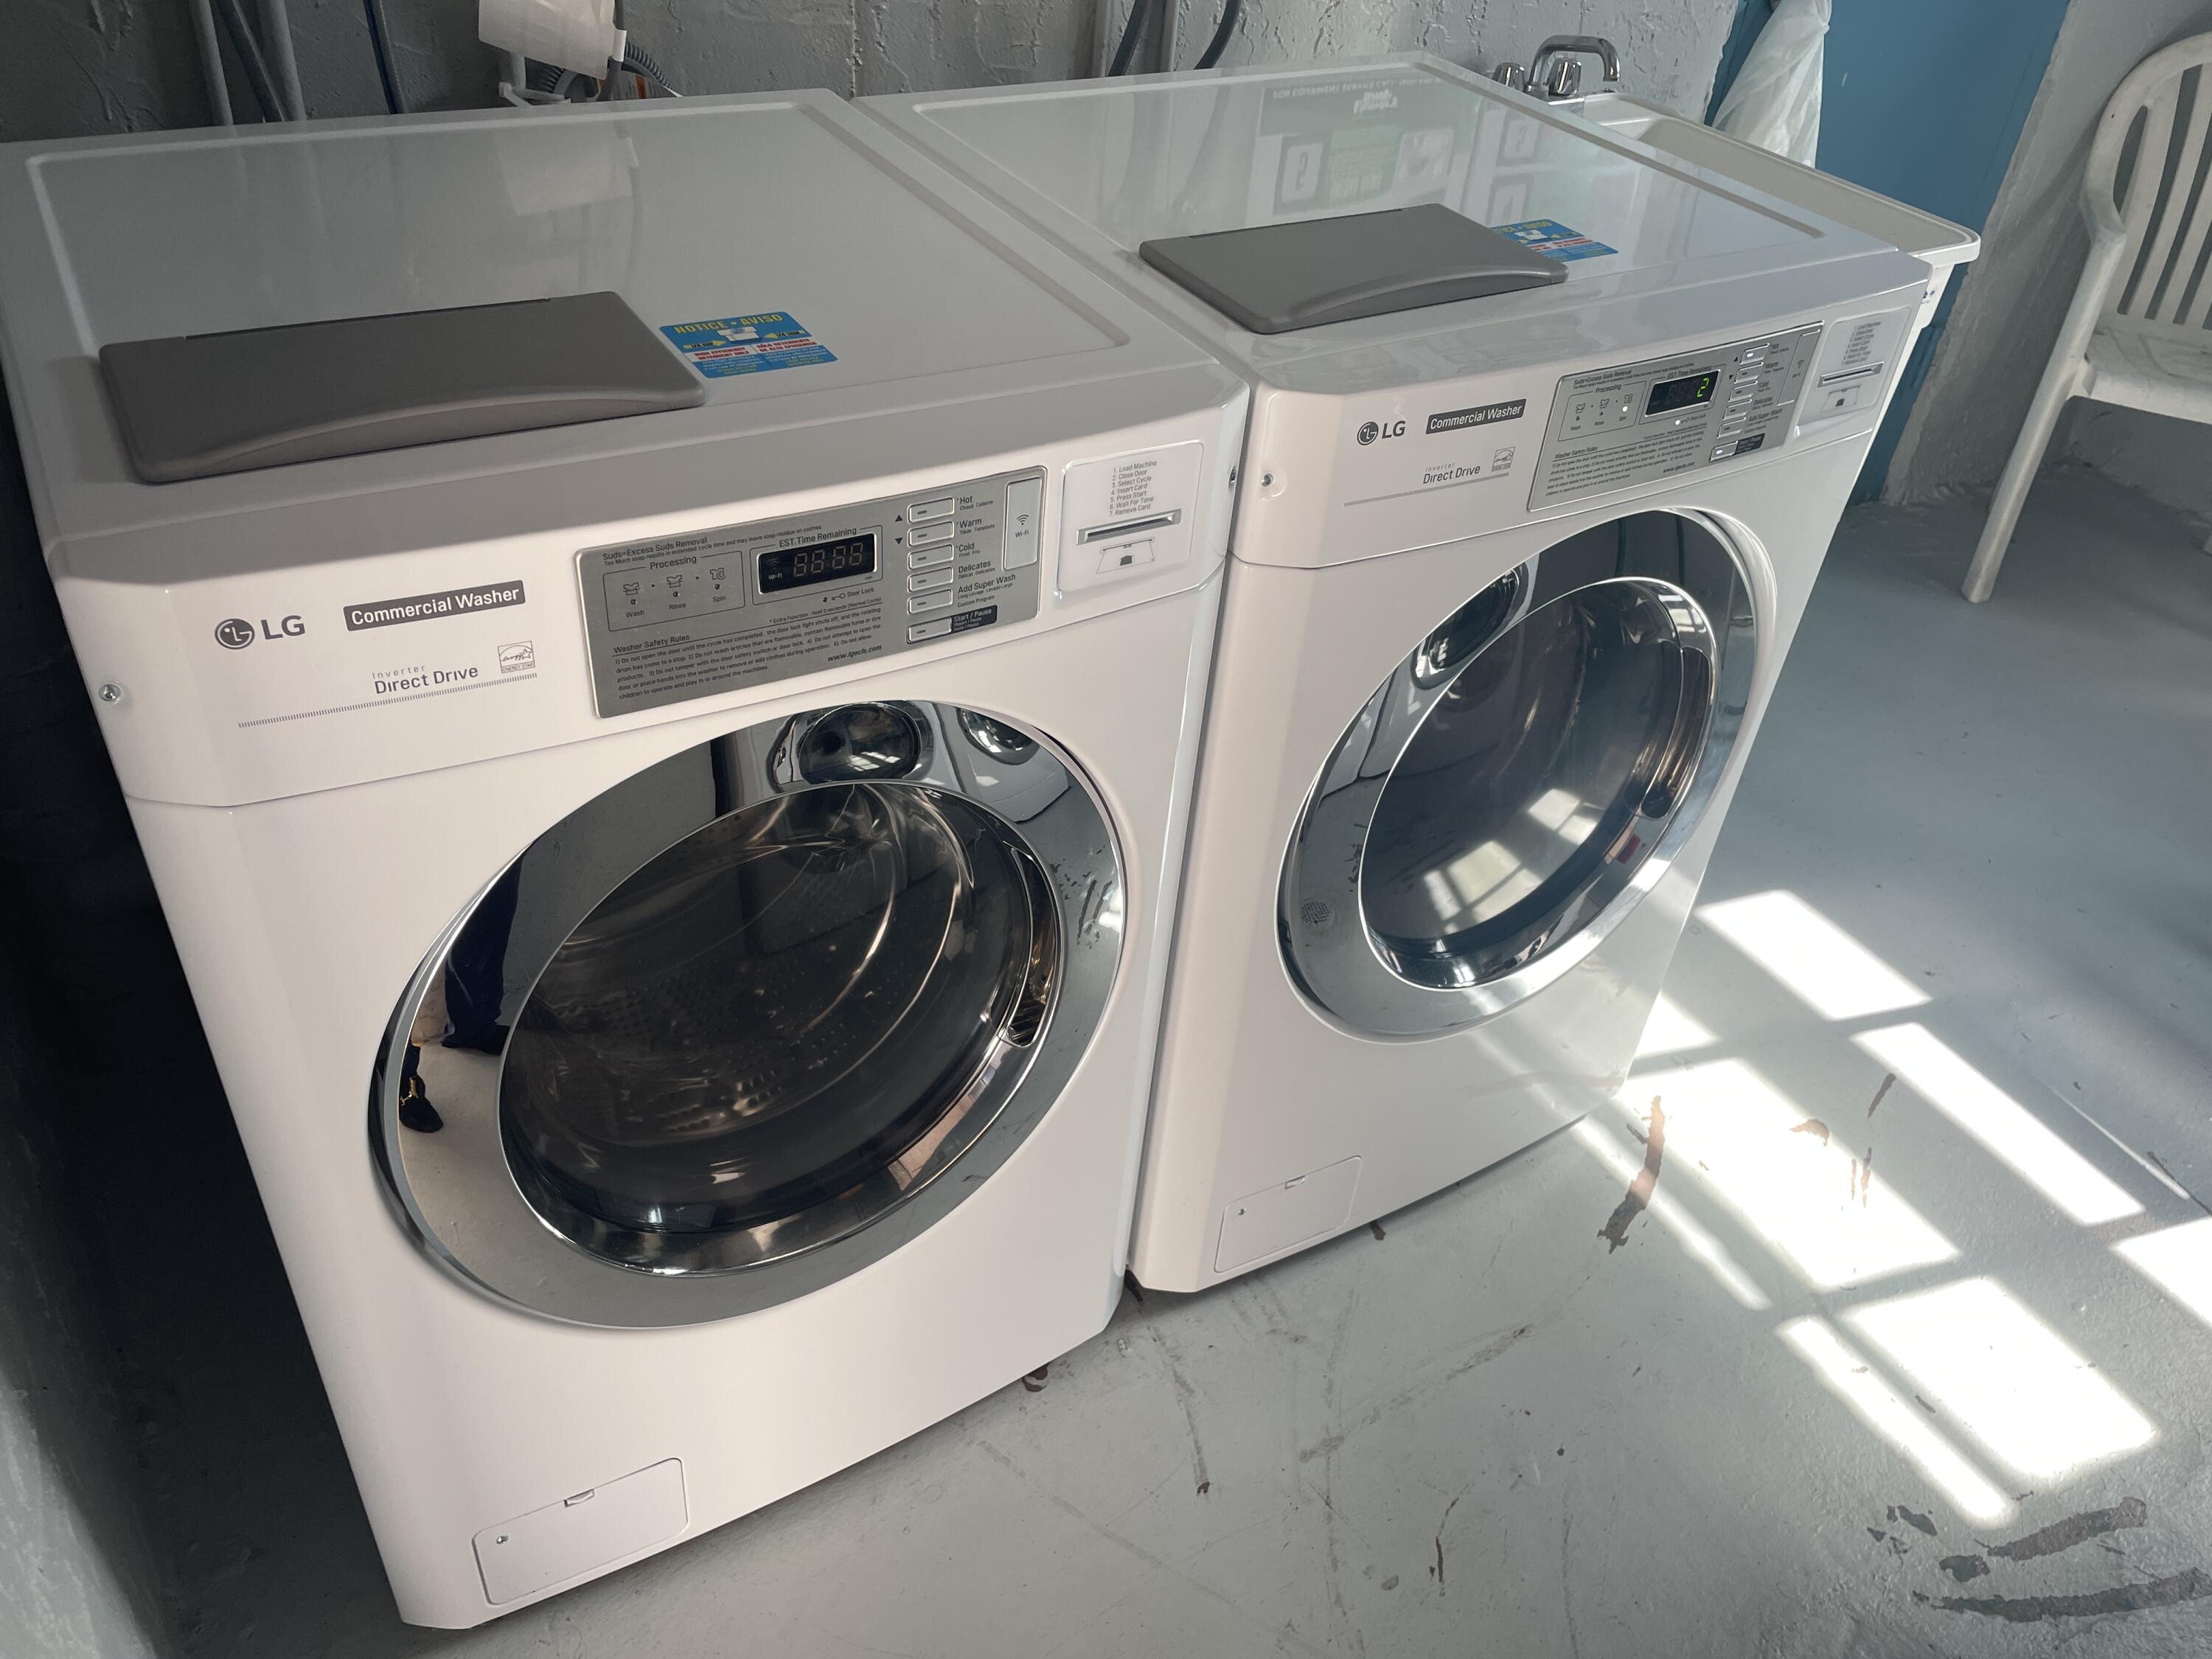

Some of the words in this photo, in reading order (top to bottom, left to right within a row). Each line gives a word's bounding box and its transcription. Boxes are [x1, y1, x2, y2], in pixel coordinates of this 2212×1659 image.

[673, 321, 727, 334] NOTICE
[740, 314, 785, 326] AVISO
[1594, 382, 1622, 395] Processing
[1696, 377, 1710, 397] 2
[1430, 410, 1485, 431] Commercial
[1486, 403, 1523, 420] Washer
[1382, 420, 1406, 439] LG
[1133, 460, 1157, 470] Machine
[1425, 462, 1455, 472] Inverter
[1119, 472, 1134, 480] Close
[1134, 469, 1147, 477] Door
[1136, 476, 1152, 484] Cycle
[1423, 470, 1454, 484] Direct
[1455, 464, 1481, 478] Drive
[1117, 486, 1133, 494] Insert
[1134, 483, 1147, 491] Card
[960, 495, 972, 504] Hot
[1116, 493, 1132, 501] Press
[1115, 507, 1137, 516] Remove
[1137, 504, 1150, 512] Card
[1116, 500, 1130, 509] Wait
[959, 517, 981, 528] Warm
[817, 526, 856, 542] Remaining
[1015, 529, 1029, 538] Wi-Fi
[655, 542, 674, 552] Suds
[675, 536, 707, 549] Removal
[959, 542, 974, 552] Cold
[645, 551, 663, 559] results
[672, 546, 697, 554] extended
[698, 543, 714, 551] cycle
[649, 554, 696, 572] Processing
[959, 560, 990, 573] Delicates
[768, 571, 782, 580] Wi-Fi
[861, 586, 874, 594] Lock
[958, 584, 972, 594] Add
[974, 579, 994, 591] Super
[996, 573, 1015, 584] Wash
[712, 594, 726, 603] Spin
[975, 594, 994, 603] Program
[350, 597, 453, 626] Commercial
[455, 586, 520, 611] Washer
[669, 601, 686, 611] Rinse
[827, 604, 846, 612] seconds
[625, 608, 644, 618] Wash
[953, 613, 968, 622] Start
[974, 608, 992, 616] Pause
[260, 615, 306, 641] LG
[641, 653, 655, 661] open
[667, 647, 681, 655] door
[706, 639, 721, 648] cycle
[860, 607, 880, 616] rotating
[613, 641, 642, 654] Washer
[644, 637, 668, 650] Safety
[669, 633, 689, 643] Rules
[616, 666, 631, 674] drum
[714, 647, 728, 655] wash
[730, 642, 751, 651] articles
[804, 627, 823, 636] contain
[824, 622, 849, 632] flammable
[675, 662, 695, 672] tamper
[734, 651, 751, 659] safety
[753, 647, 771, 655] switch
[832, 630, 852, 639] attempt
[372, 664, 425, 680] Inverter
[639, 678, 655, 687] place
[657, 675, 673, 683] hands
[698, 666, 717, 675] washer
[726, 661, 747, 669] remove
[766, 653, 785, 661] clothes
[786, 649, 803, 657] during
[374, 674, 429, 695] Direct
[433, 665, 479, 685] Drive
[619, 690, 642, 700] children
[650, 684, 672, 694] operate
[685, 679, 697, 687] play
[712, 672, 731, 681] around
